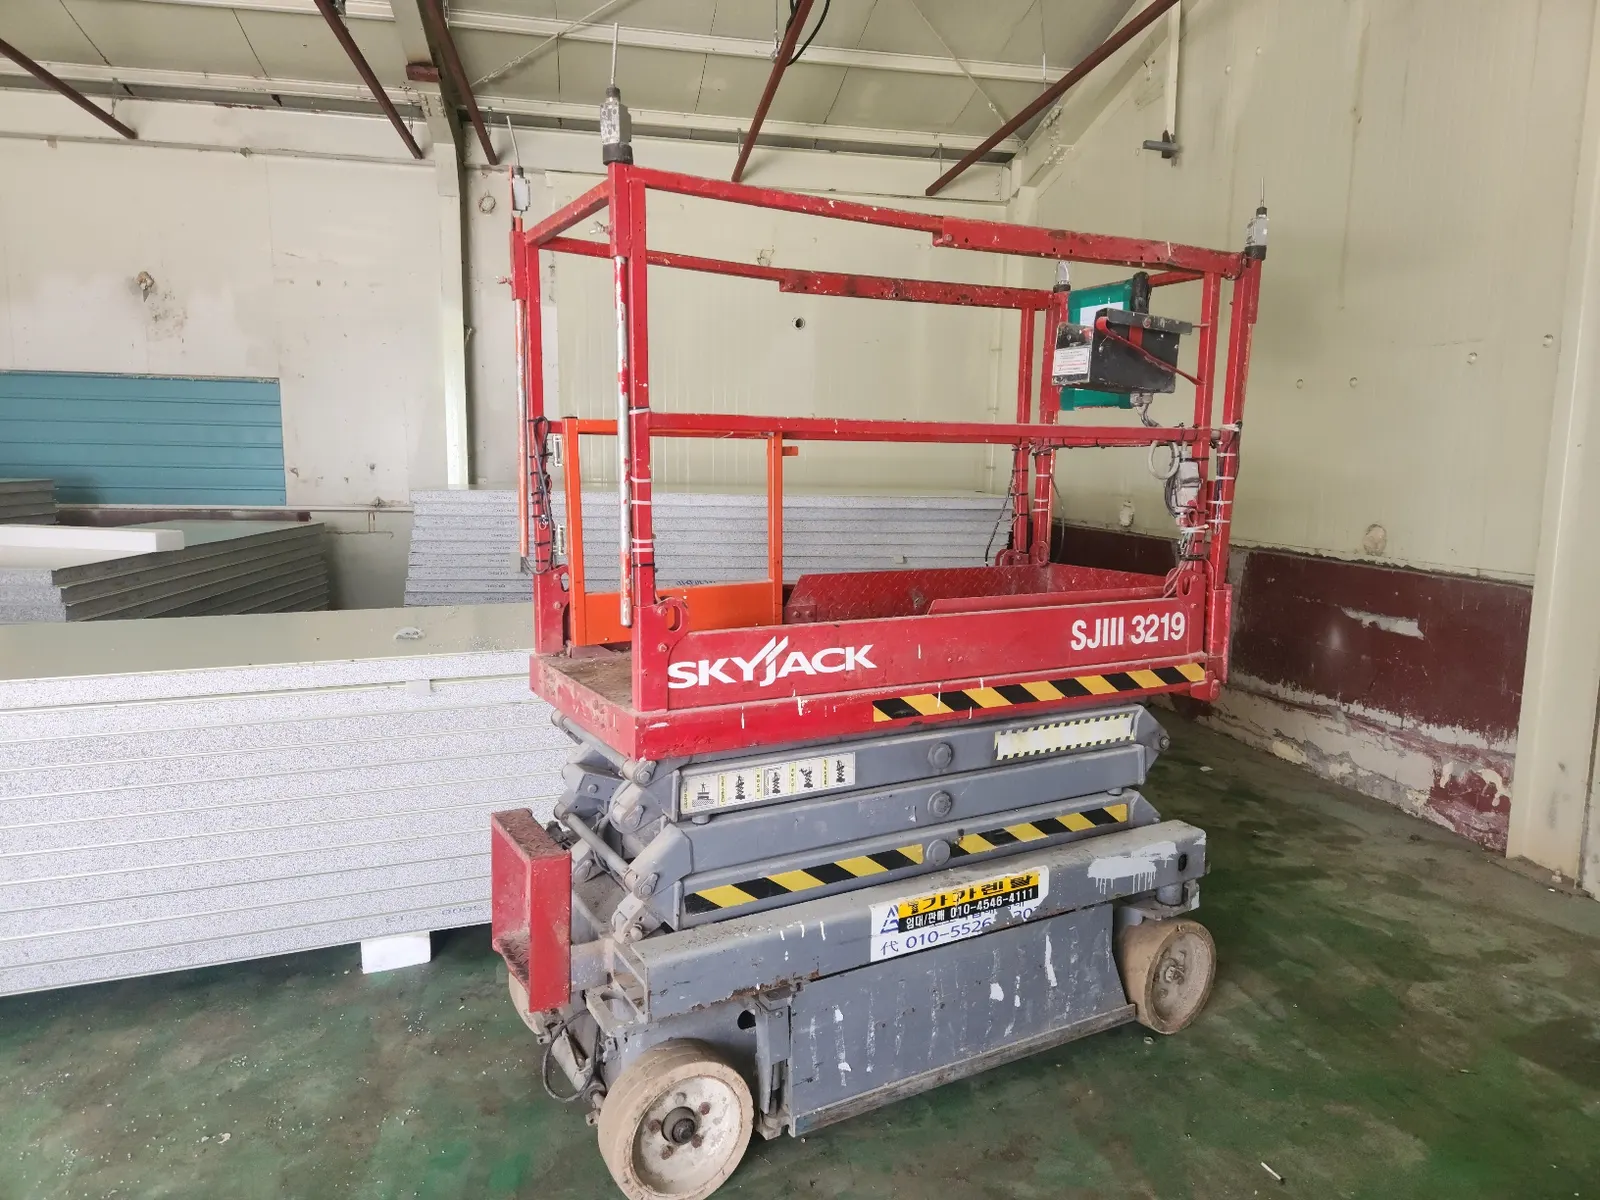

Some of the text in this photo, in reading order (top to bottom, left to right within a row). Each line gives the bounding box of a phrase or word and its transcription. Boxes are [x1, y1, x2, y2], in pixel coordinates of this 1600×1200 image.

[1070, 612, 1186, 651] SJIII 3219
[667, 636, 878, 689] SKYJACK
[906, 909, 945, 931] 임대/판매
[950, 888, 1034, 918] 010-4546-4111
[880, 940, 899, 956] 代
